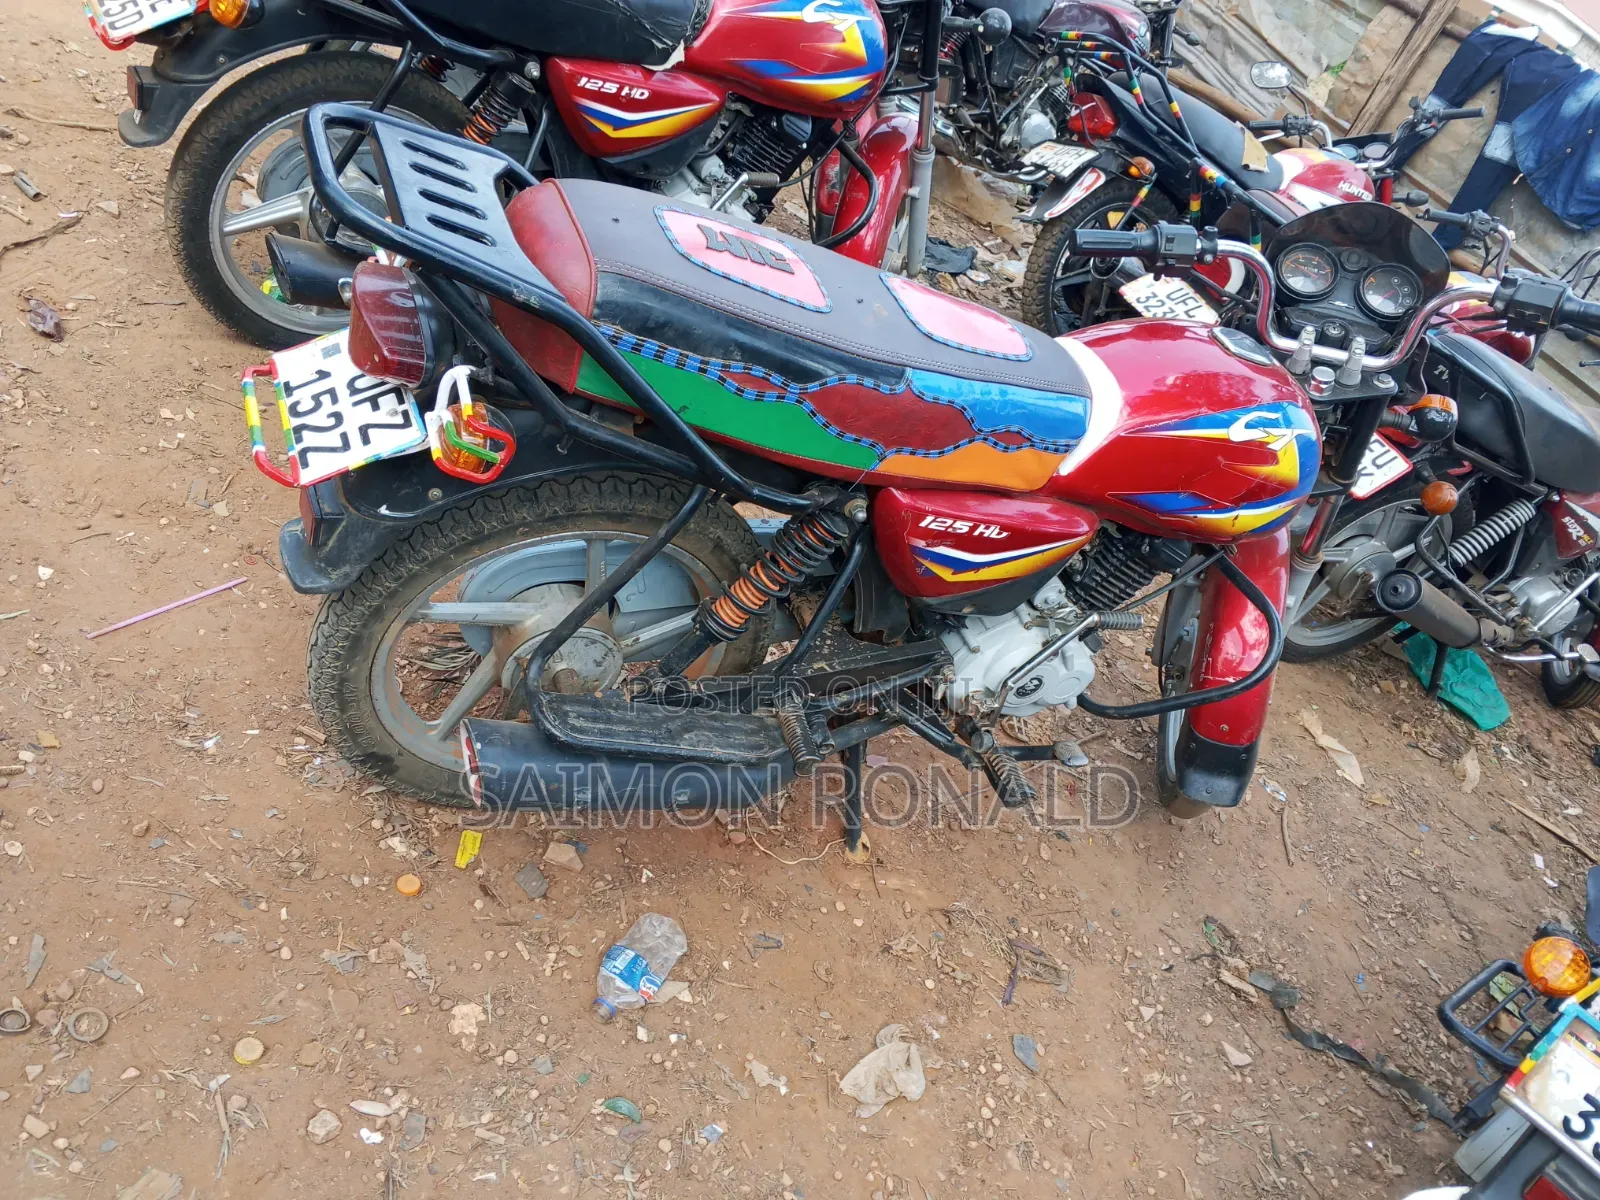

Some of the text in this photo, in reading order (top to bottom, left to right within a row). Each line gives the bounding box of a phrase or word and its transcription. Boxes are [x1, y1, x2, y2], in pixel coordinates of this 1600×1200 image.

[577, 76, 651, 100] 125 HD
[1135, 291, 1179, 318] 323
[1165, 287, 1203, 318] UFL
[1433, 364, 1449, 384] TV
[283, 369, 351, 470] 152Z
[346, 373, 413, 447] UFZ
[918, 514, 974, 534] 125
